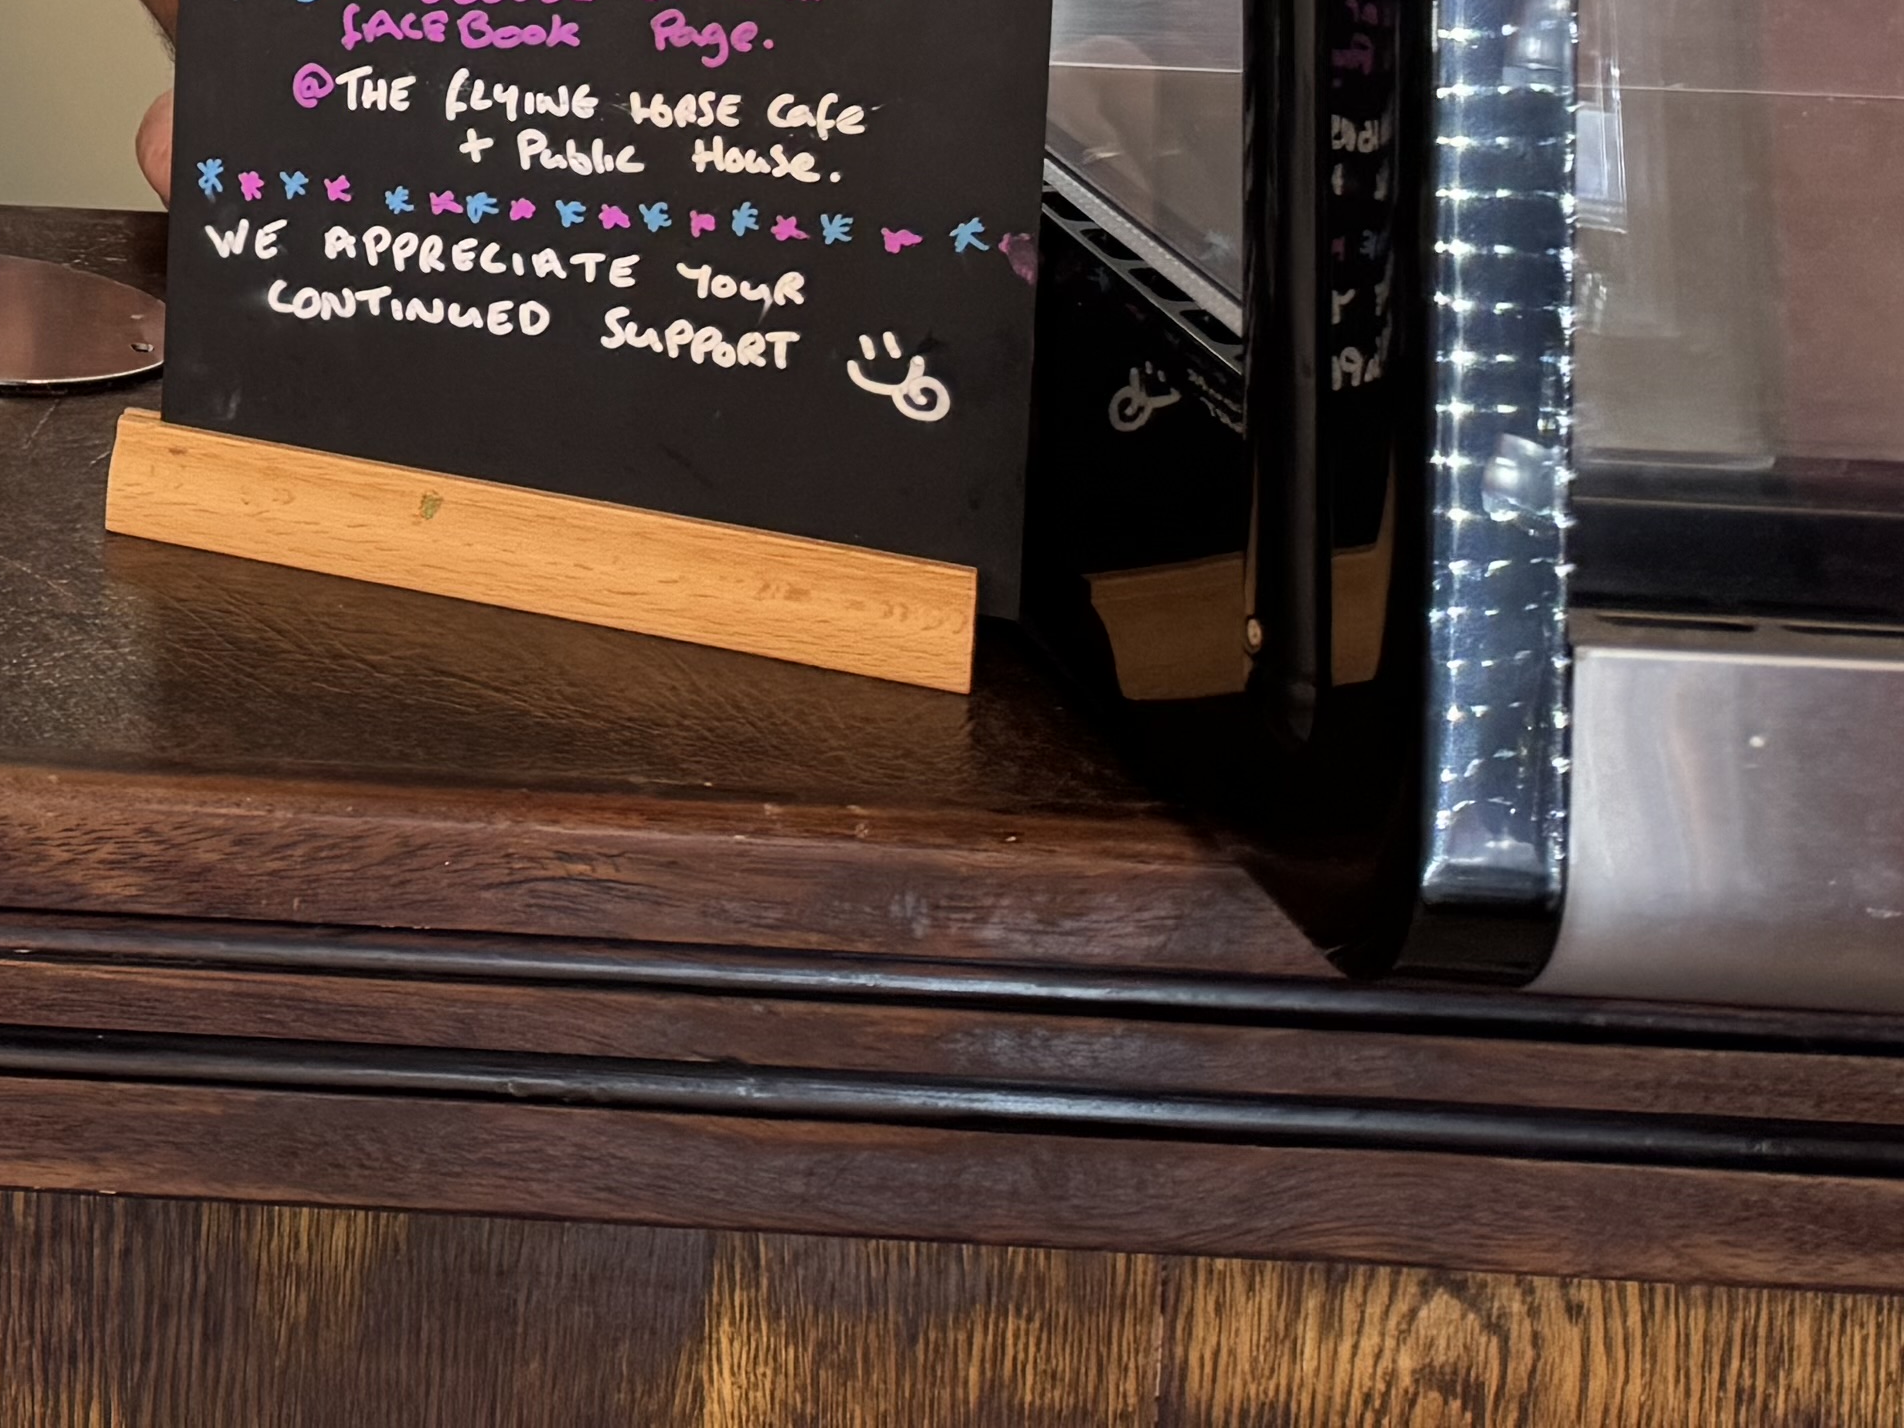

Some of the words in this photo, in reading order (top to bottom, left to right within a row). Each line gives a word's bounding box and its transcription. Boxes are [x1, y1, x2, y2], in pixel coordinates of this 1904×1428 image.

[630, 91, 742, 129] HORSE
[517, 130, 645, 175] Public
[204, 220, 280, 261] WE
[324, 225, 640, 289] APPRECIATE
[677, 260, 807, 308] YOUR
[266, 280, 552, 339] CONTINUED
[600, 307, 801, 371] SUPPORT
